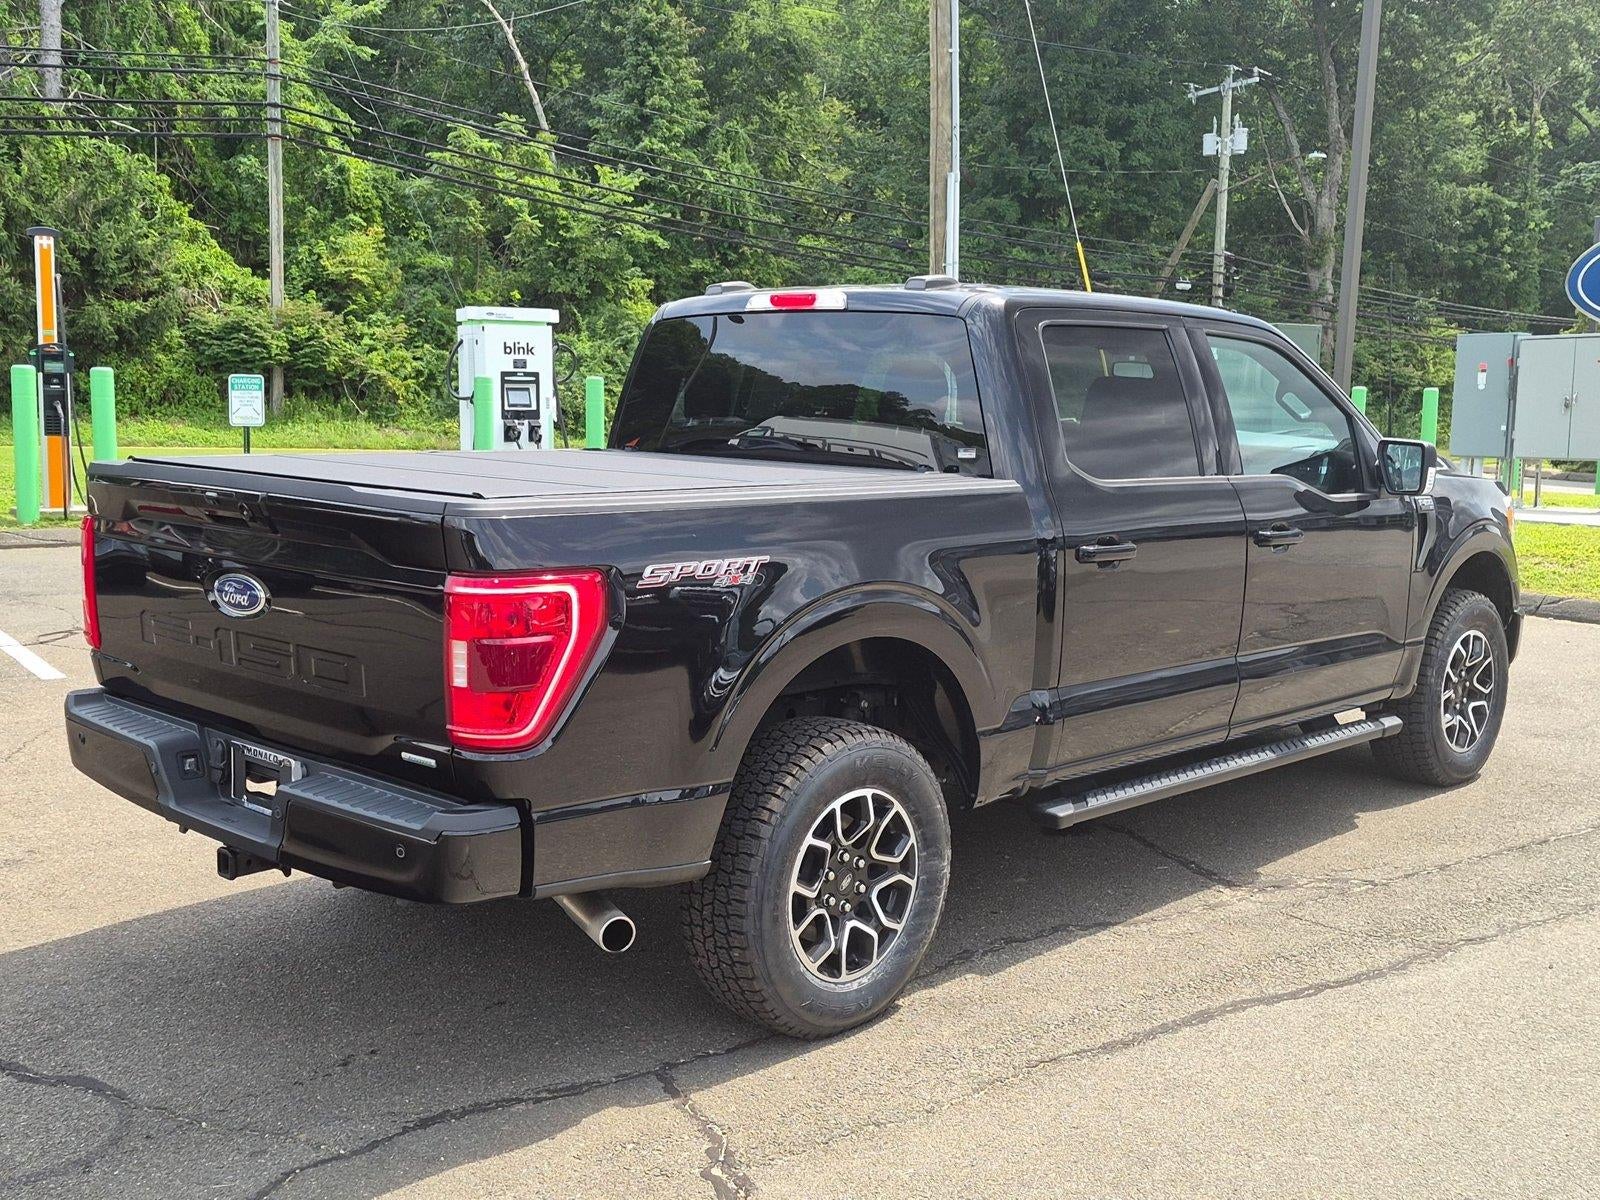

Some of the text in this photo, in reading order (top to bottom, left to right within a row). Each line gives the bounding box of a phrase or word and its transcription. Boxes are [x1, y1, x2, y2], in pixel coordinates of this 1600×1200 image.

[503, 341, 535, 356] blink
[636, 555, 771, 589] SPORT
[221, 580, 250, 607] Ford
[140, 608, 367, 698] F-150
[245, 746, 279, 765] MONACO
